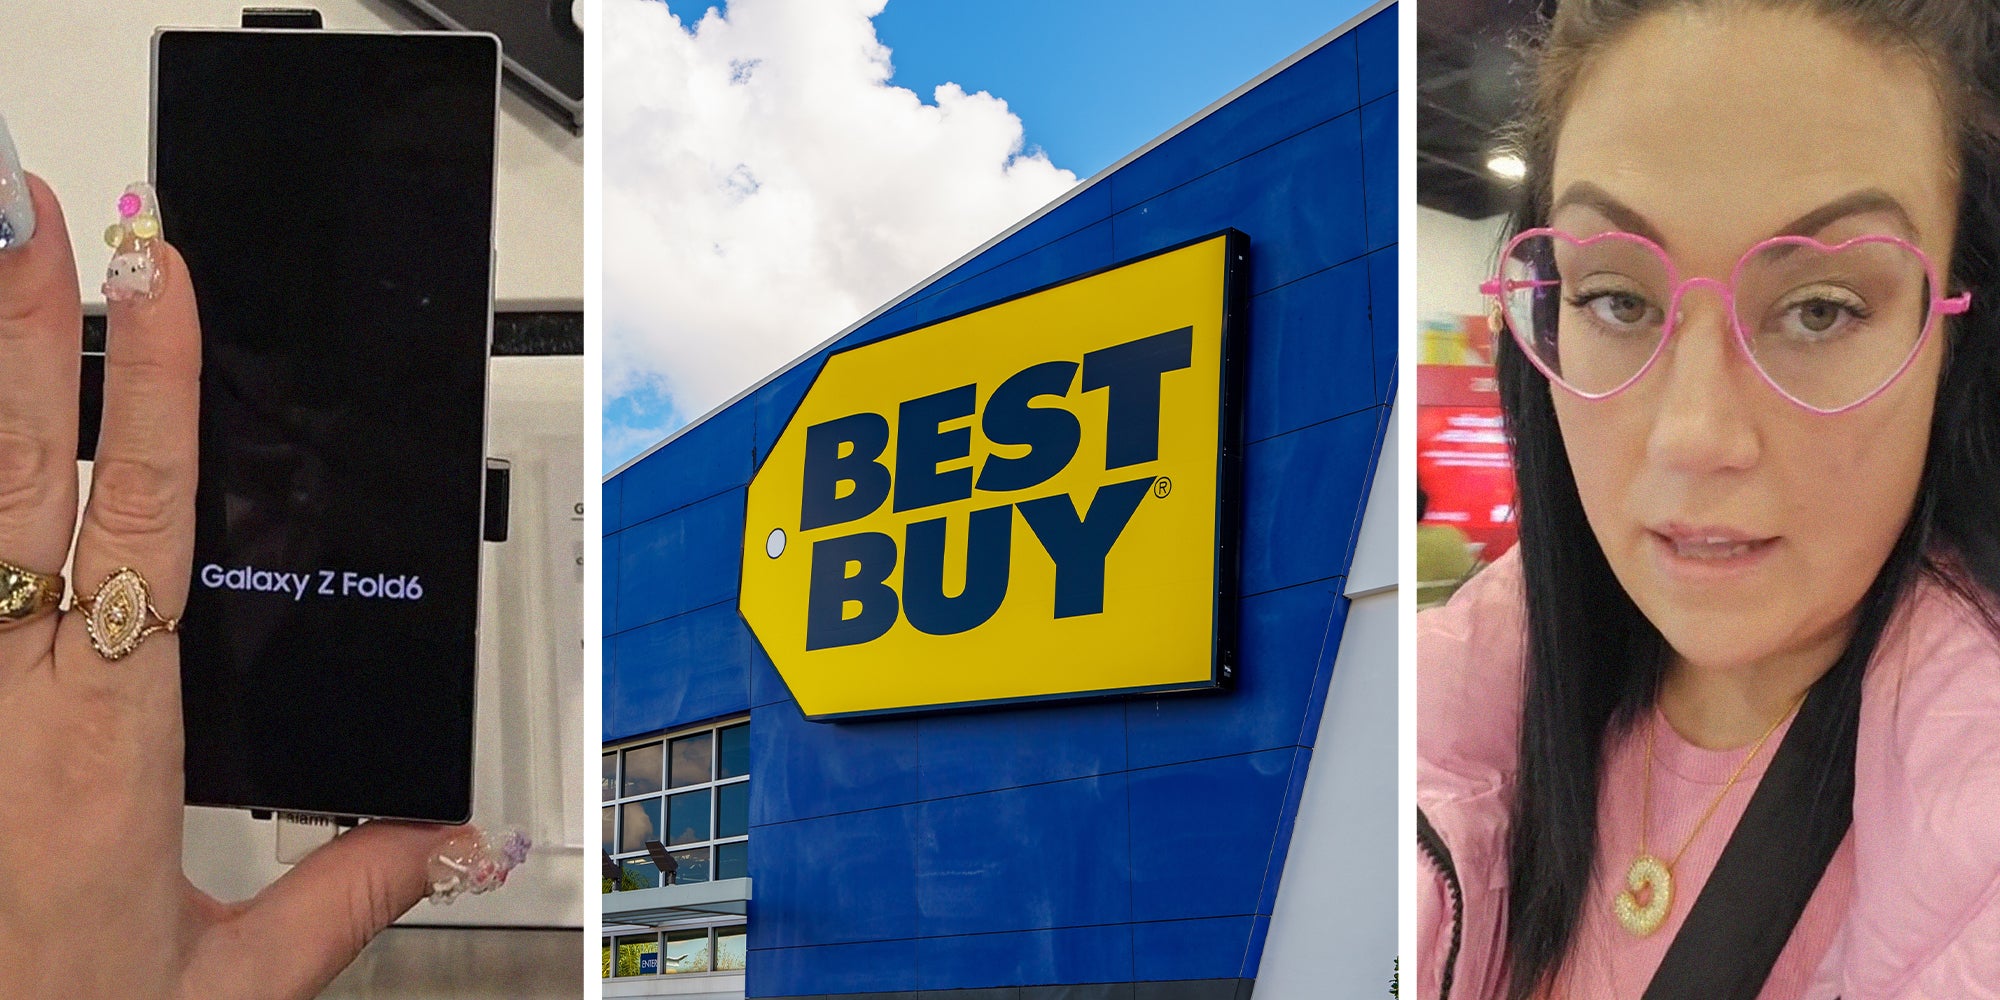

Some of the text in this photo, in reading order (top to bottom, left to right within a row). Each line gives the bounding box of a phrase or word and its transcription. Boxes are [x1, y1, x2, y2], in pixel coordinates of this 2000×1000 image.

[800, 326, 1193, 531] BEST
[201, 564, 423, 600] Galaxy Z Fold6
